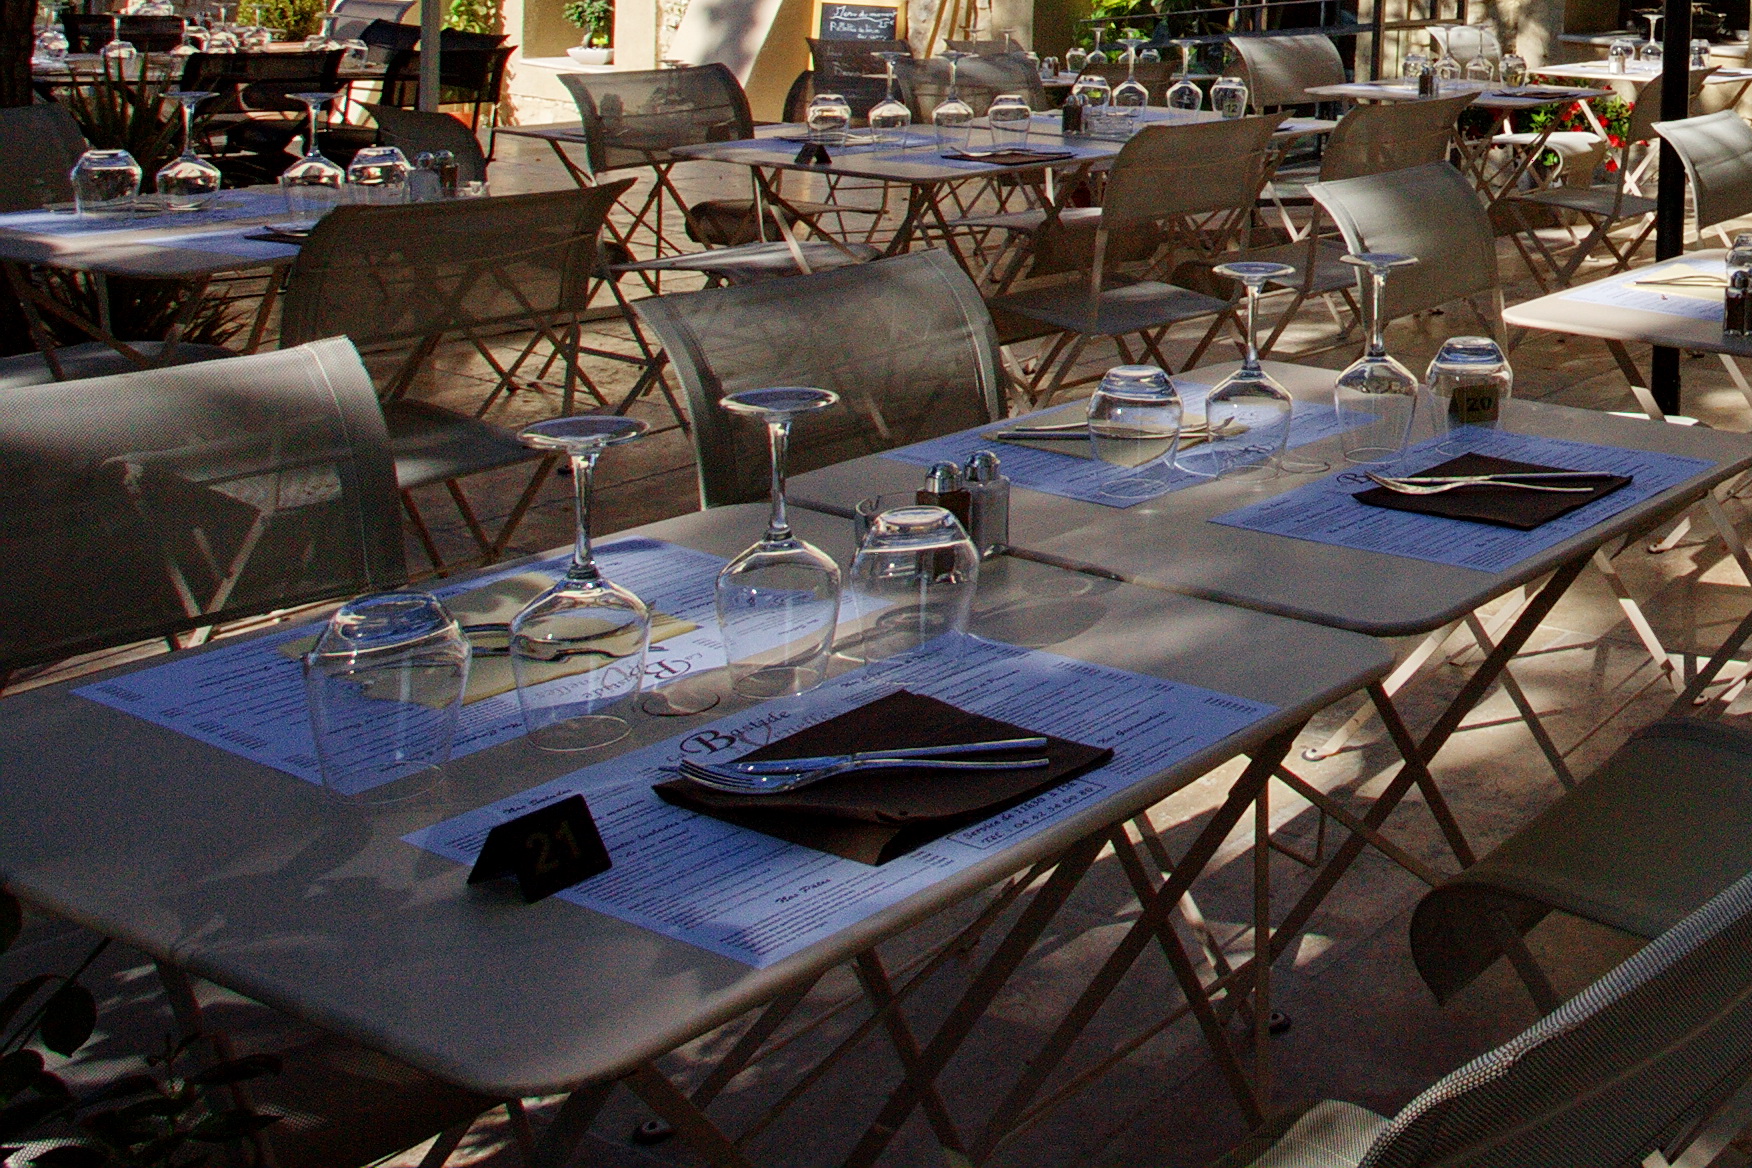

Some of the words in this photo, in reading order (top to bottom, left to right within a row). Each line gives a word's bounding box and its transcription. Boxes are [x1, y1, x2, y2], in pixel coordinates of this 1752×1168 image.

[1466, 396, 1492, 412] 20
[679, 708, 792, 755] Bastide
[525, 820, 582, 876] 21
